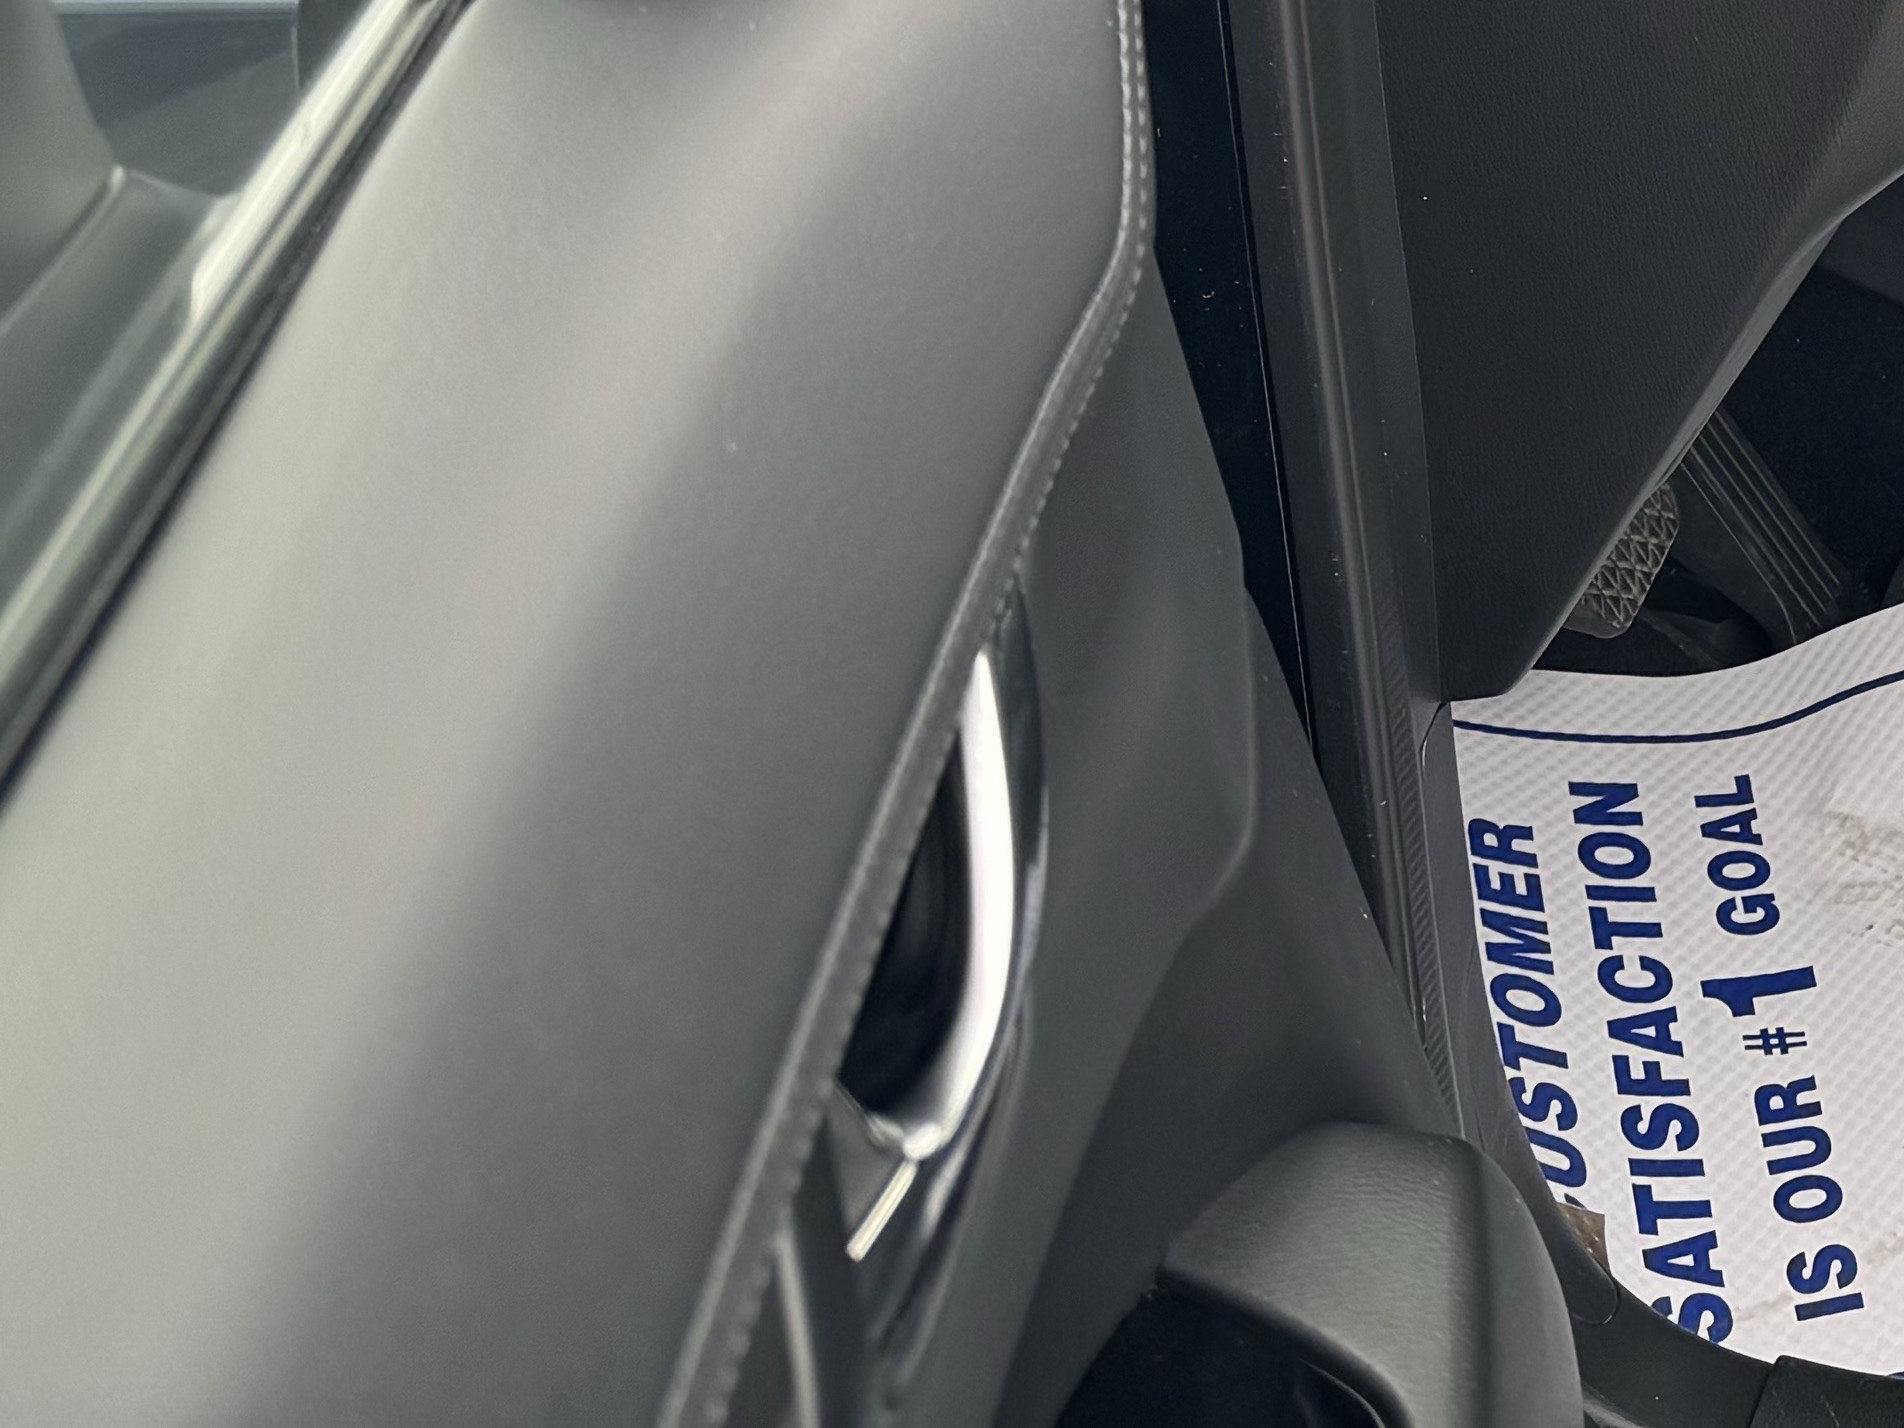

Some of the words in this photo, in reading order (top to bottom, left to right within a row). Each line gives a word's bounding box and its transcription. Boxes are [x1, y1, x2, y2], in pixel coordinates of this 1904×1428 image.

[1694, 774, 1781, 936] GOAL
[1468, 818, 1588, 1207] USTOMER
[1569, 781, 1734, 1344] SATISFACTION
[1754, 1075, 1843, 1224] OUR
[1786, 1244, 1864, 1322] IS
